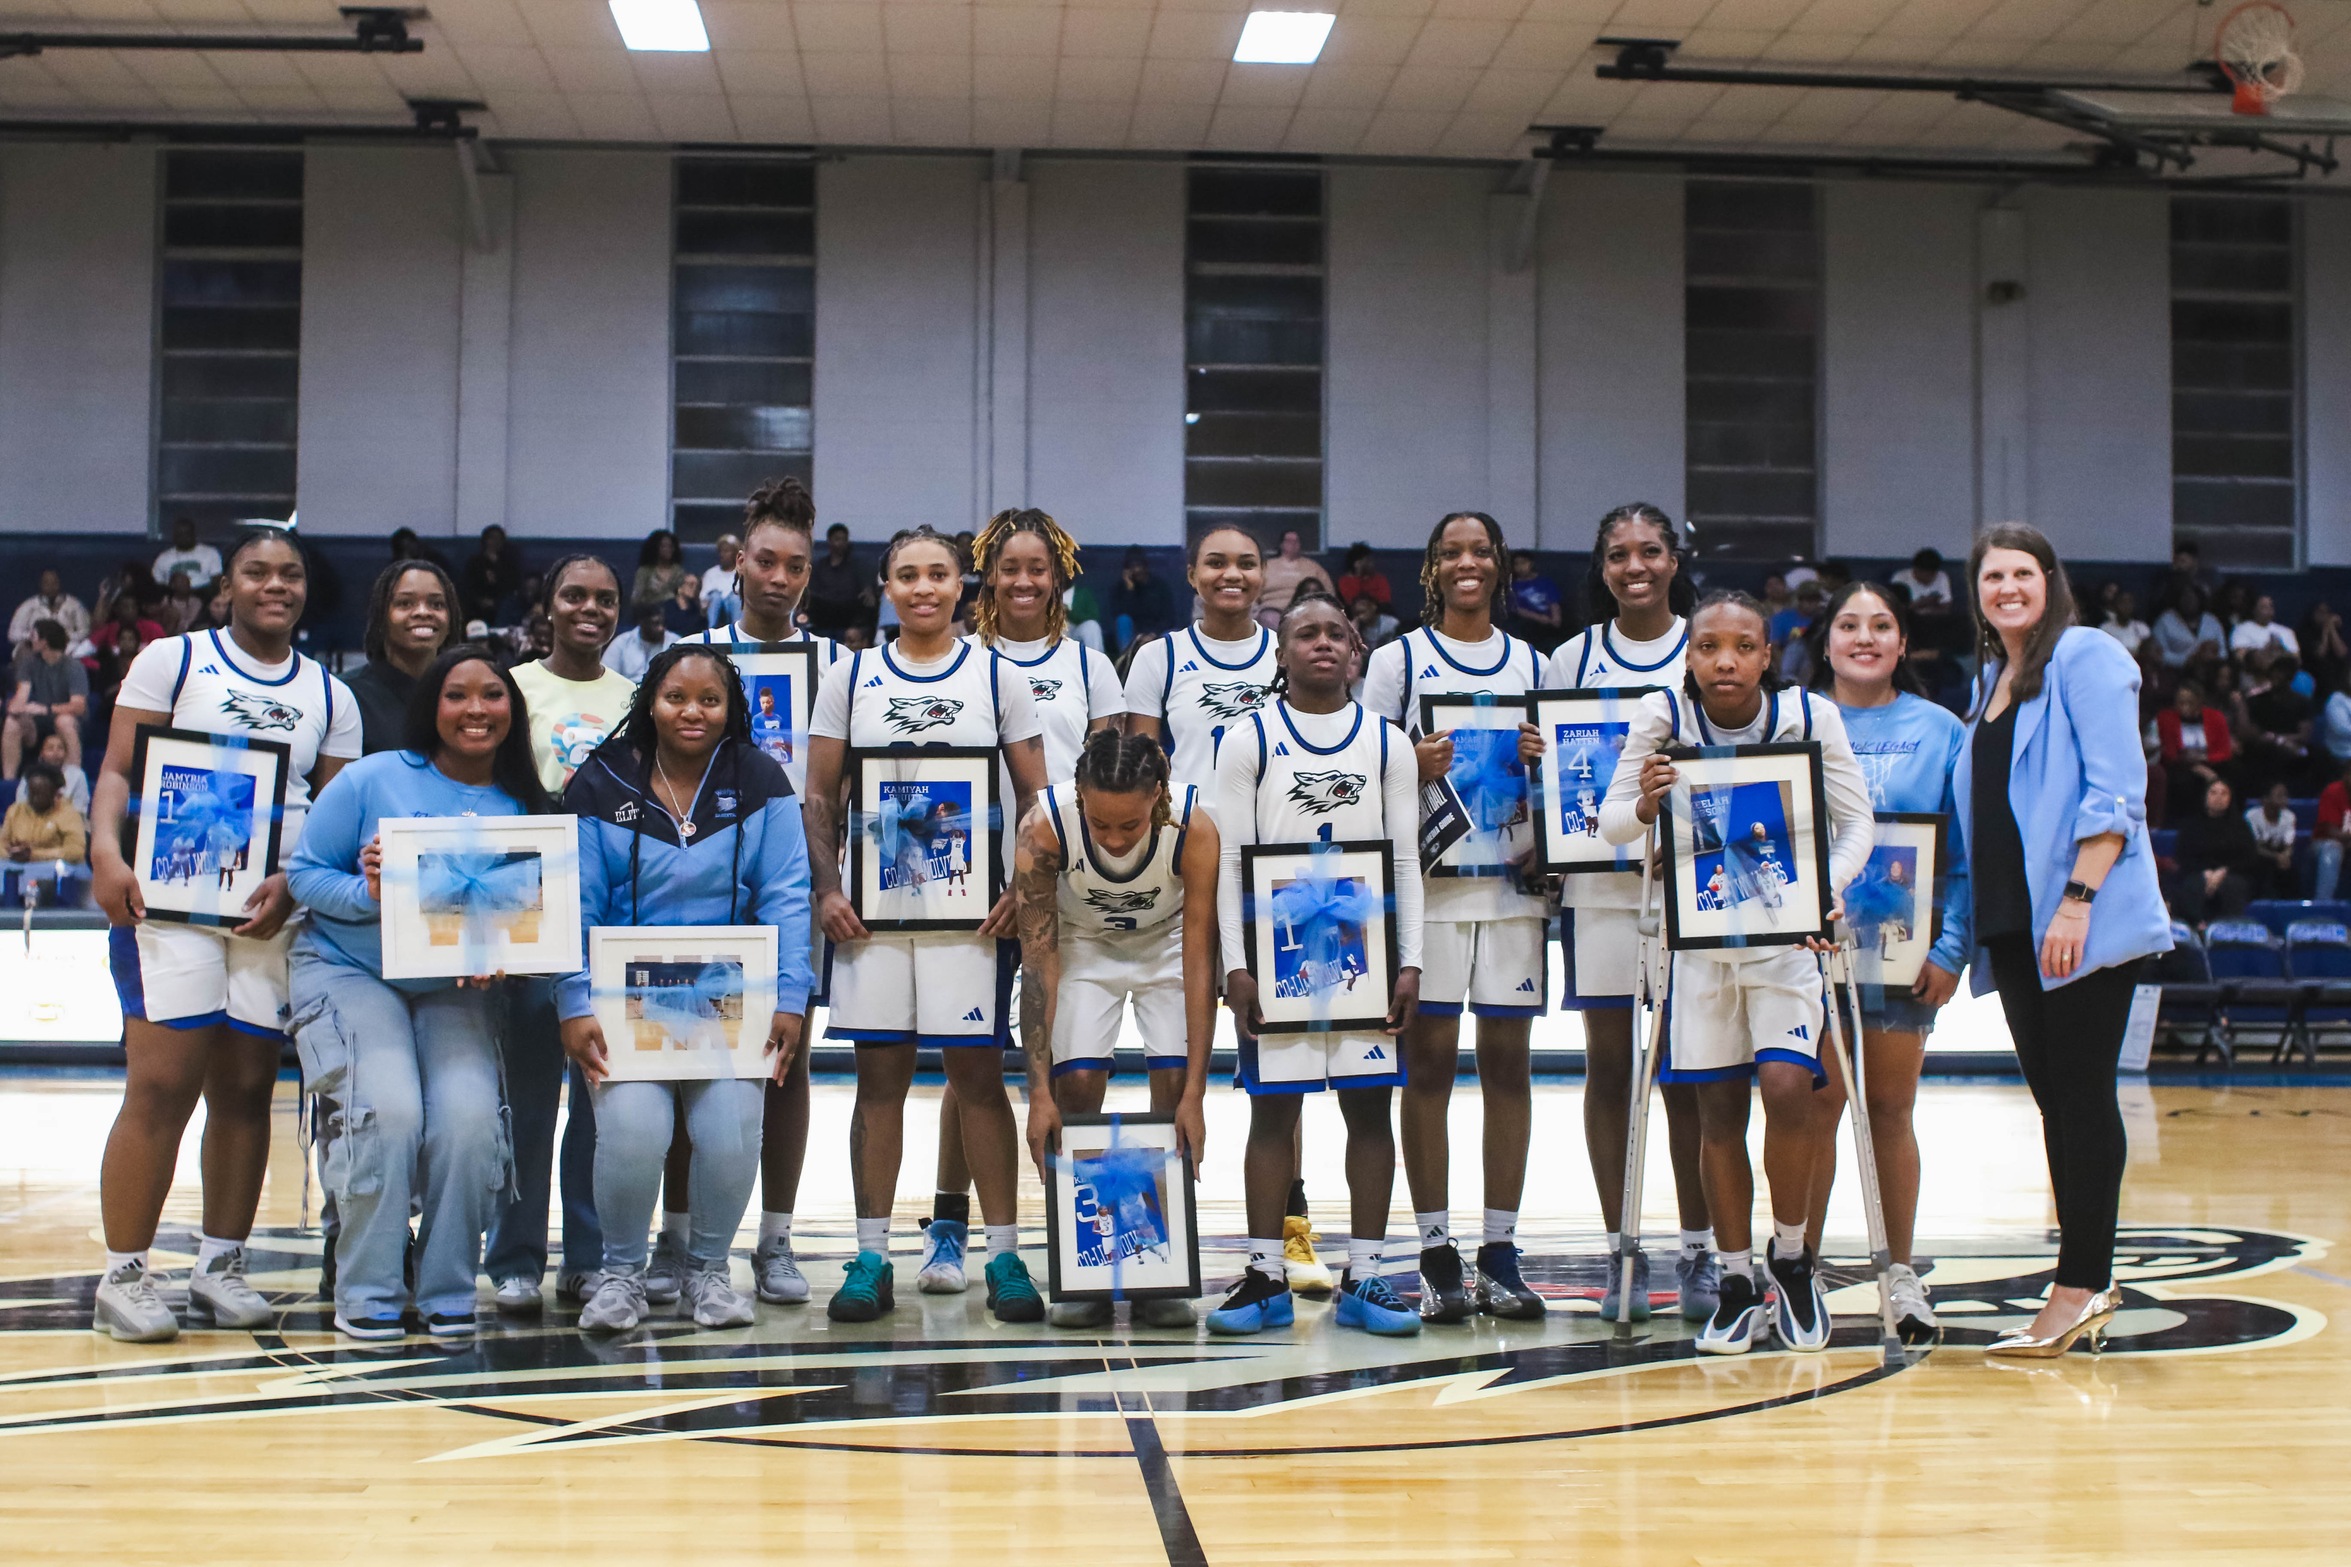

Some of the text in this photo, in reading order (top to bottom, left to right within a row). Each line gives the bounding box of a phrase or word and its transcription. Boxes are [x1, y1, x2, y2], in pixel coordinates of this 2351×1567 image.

[1563, 729, 1600, 738] ZARIAH
[1562, 738, 1600, 747] HATTEN
[1876, 740, 1922, 752] LEGACY
[1567, 747, 1593, 779] 4
[883, 785, 930, 794] KAMIYAH
[160, 790, 179, 825] 1
[614, 808, 645, 823] ELIT
[1073, 1183, 1101, 1223] 3
